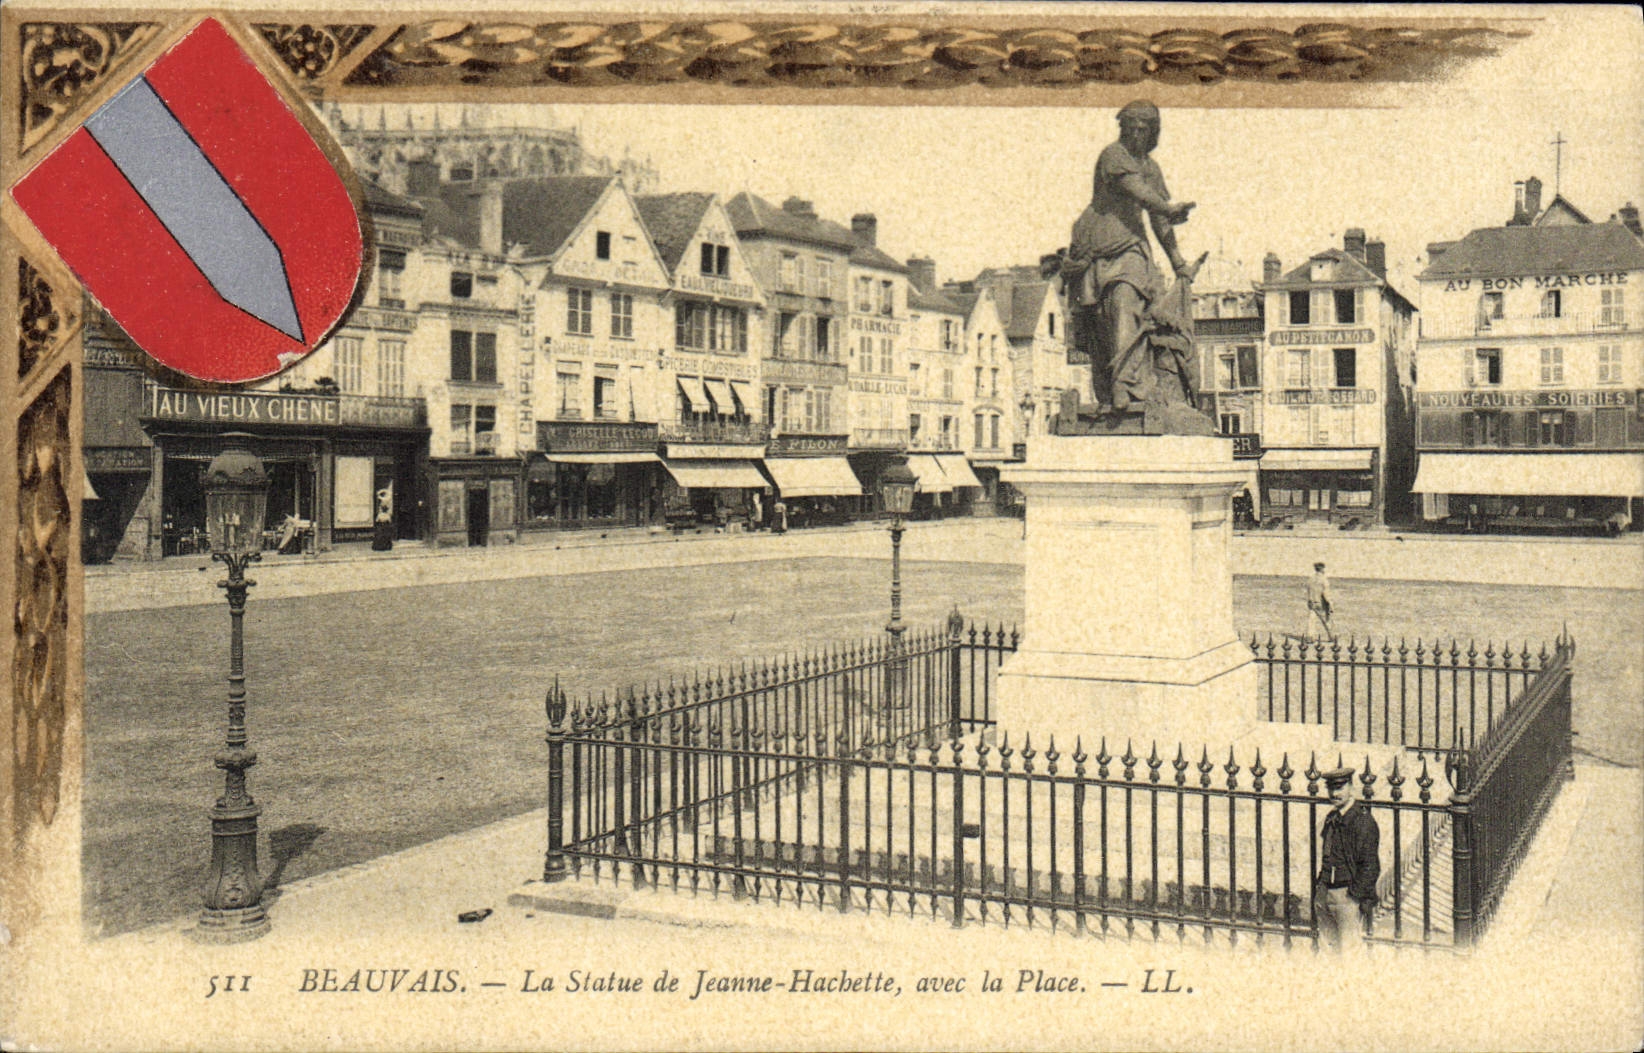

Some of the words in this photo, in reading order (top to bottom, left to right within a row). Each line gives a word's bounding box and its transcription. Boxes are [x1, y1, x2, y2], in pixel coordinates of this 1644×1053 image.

[1444, 280, 1471, 292] AU
[1483, 278, 1524, 291] BON
[851, 318, 902, 336] PHARMACIE
[159, 391, 188, 416] AU
[197, 395, 261, 419] VIEUX
[1547, 391, 1625, 406] SOIERIES
